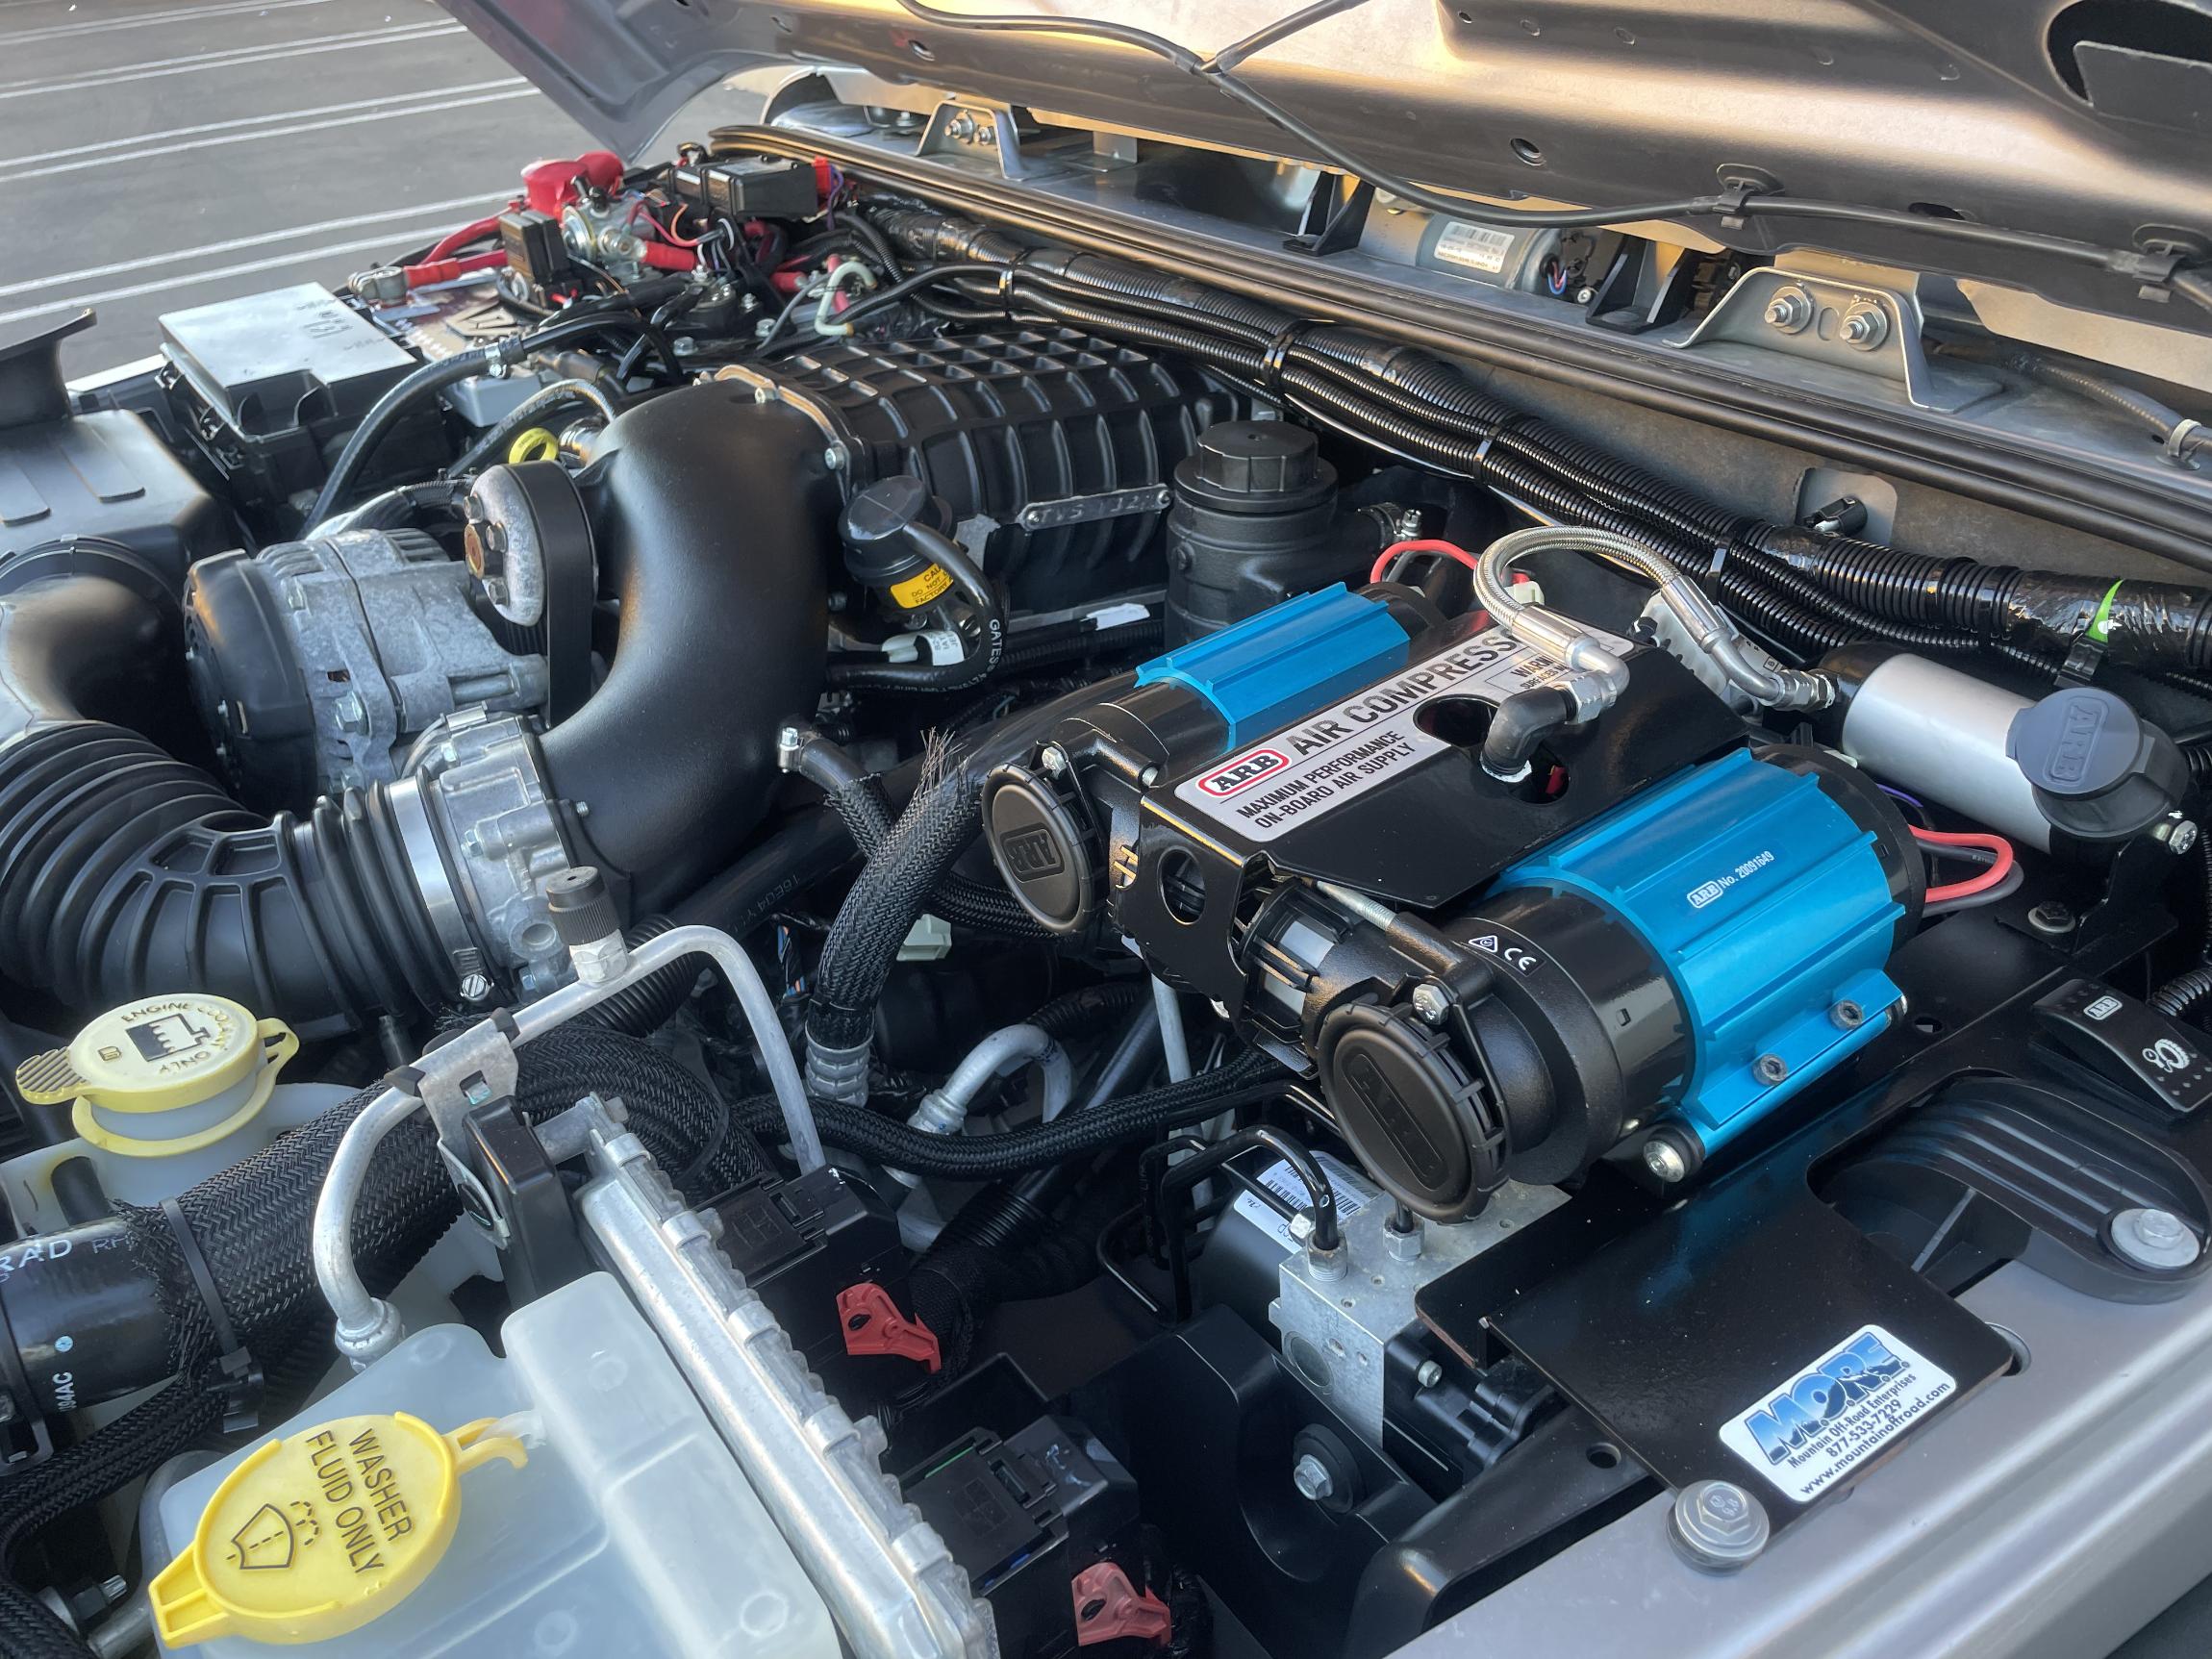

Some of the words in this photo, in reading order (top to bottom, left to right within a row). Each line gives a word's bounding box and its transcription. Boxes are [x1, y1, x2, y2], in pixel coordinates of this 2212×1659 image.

[924, 568, 941, 582] CAU
[990, 618, 1002, 664] GATES
[1511, 655, 1555, 678] WARN
[1212, 755, 1279, 792] ARB
[1285, 719, 1354, 756] AIR
[1343, 627, 1522, 723] COMPRESS
[1236, 780, 1308, 818] MAXIMUM
[1303, 730, 1405, 784] PERFORMANCE
[1255, 785, 1334, 829] ON-BOARD
[1332, 771, 1363, 791] AIR
[1357, 742, 1416, 775] SUPPLY
[1691, 884, 1720, 905] ARB
[1717, 876, 1739, 889] No.
[121, 1002, 191, 1022] ENGINE
[1788, 1433, 1830, 1469] Mountain
[1829, 1406, 1872, 1438] Off-Road
[1868, 1373, 1917, 1410] Enterprises
[1800, 1381, 1950, 1496] www.mountainoffroad.com
[1825, 1398, 1901, 1458] 877-533-7229
[306, 1430, 353, 1502] FLUID
[336, 1506, 385, 1573] ONLY
[349, 1428, 413, 1542] WASHER
